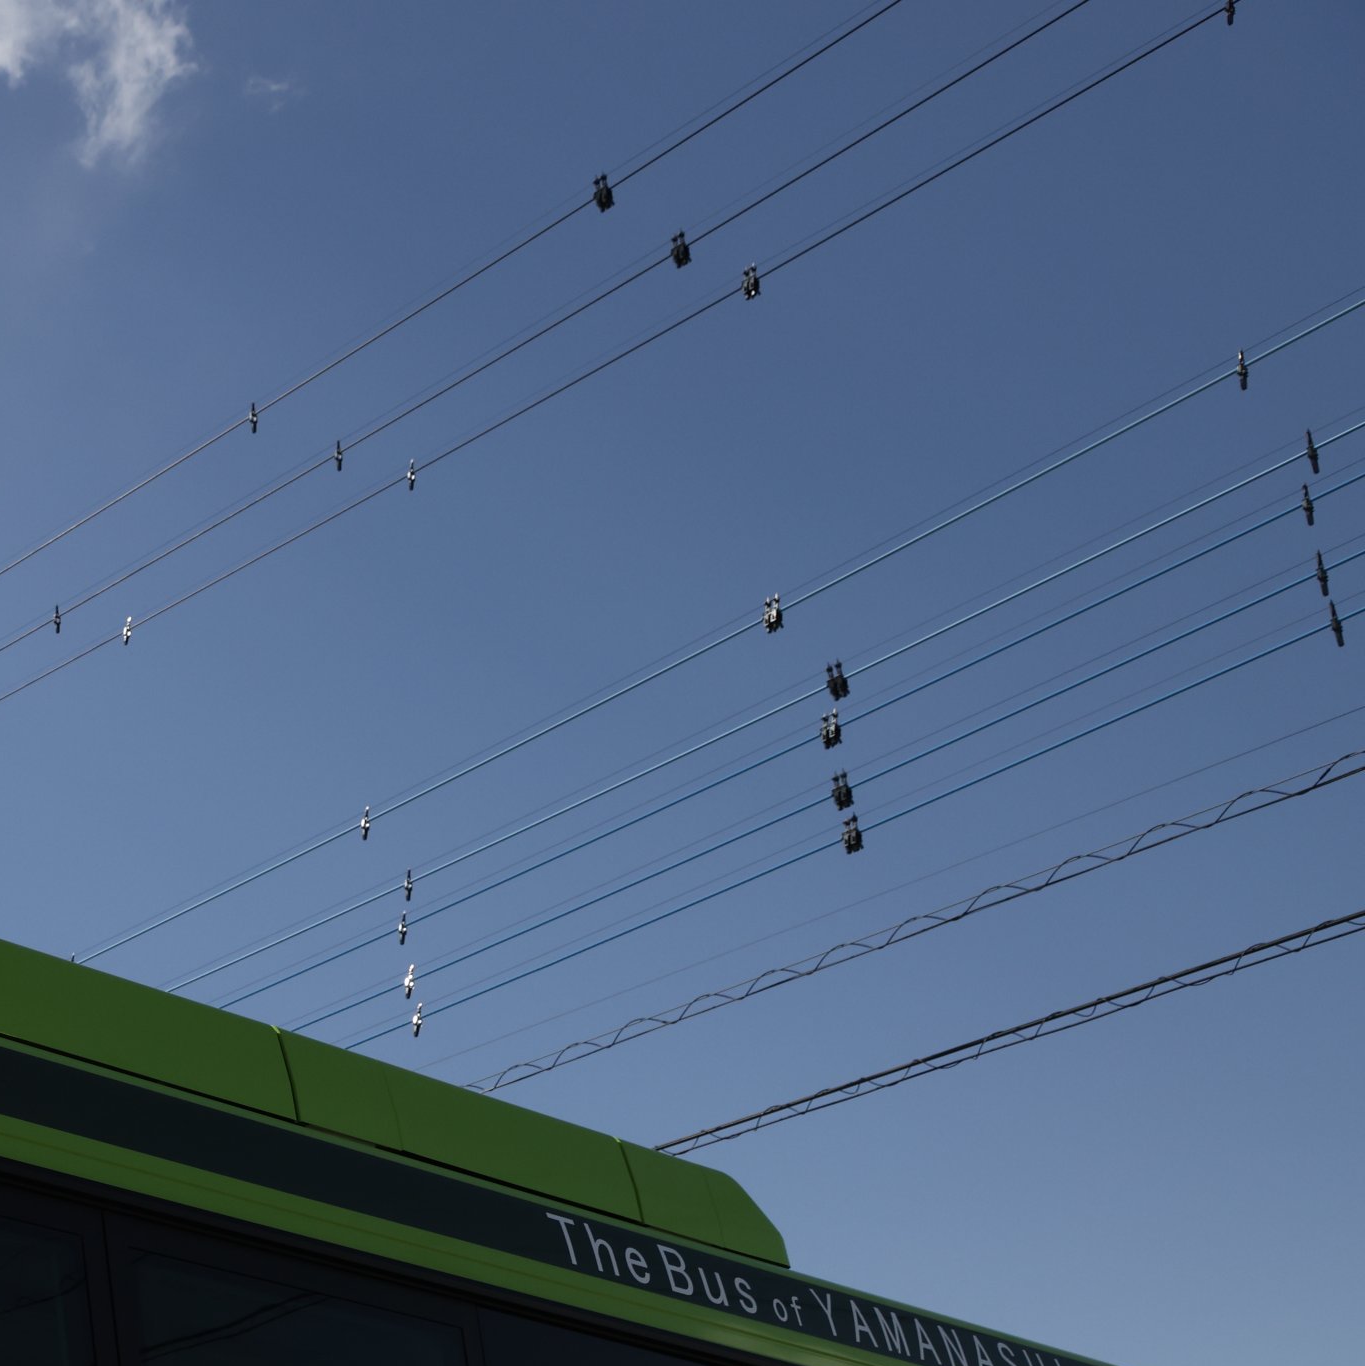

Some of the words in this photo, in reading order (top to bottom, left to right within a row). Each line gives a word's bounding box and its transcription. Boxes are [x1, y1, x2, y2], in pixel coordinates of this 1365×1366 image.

[545, 1212, 651, 1285] The
[656, 1243, 759, 1315] Bus
[772, 1296, 803, 1327] of
